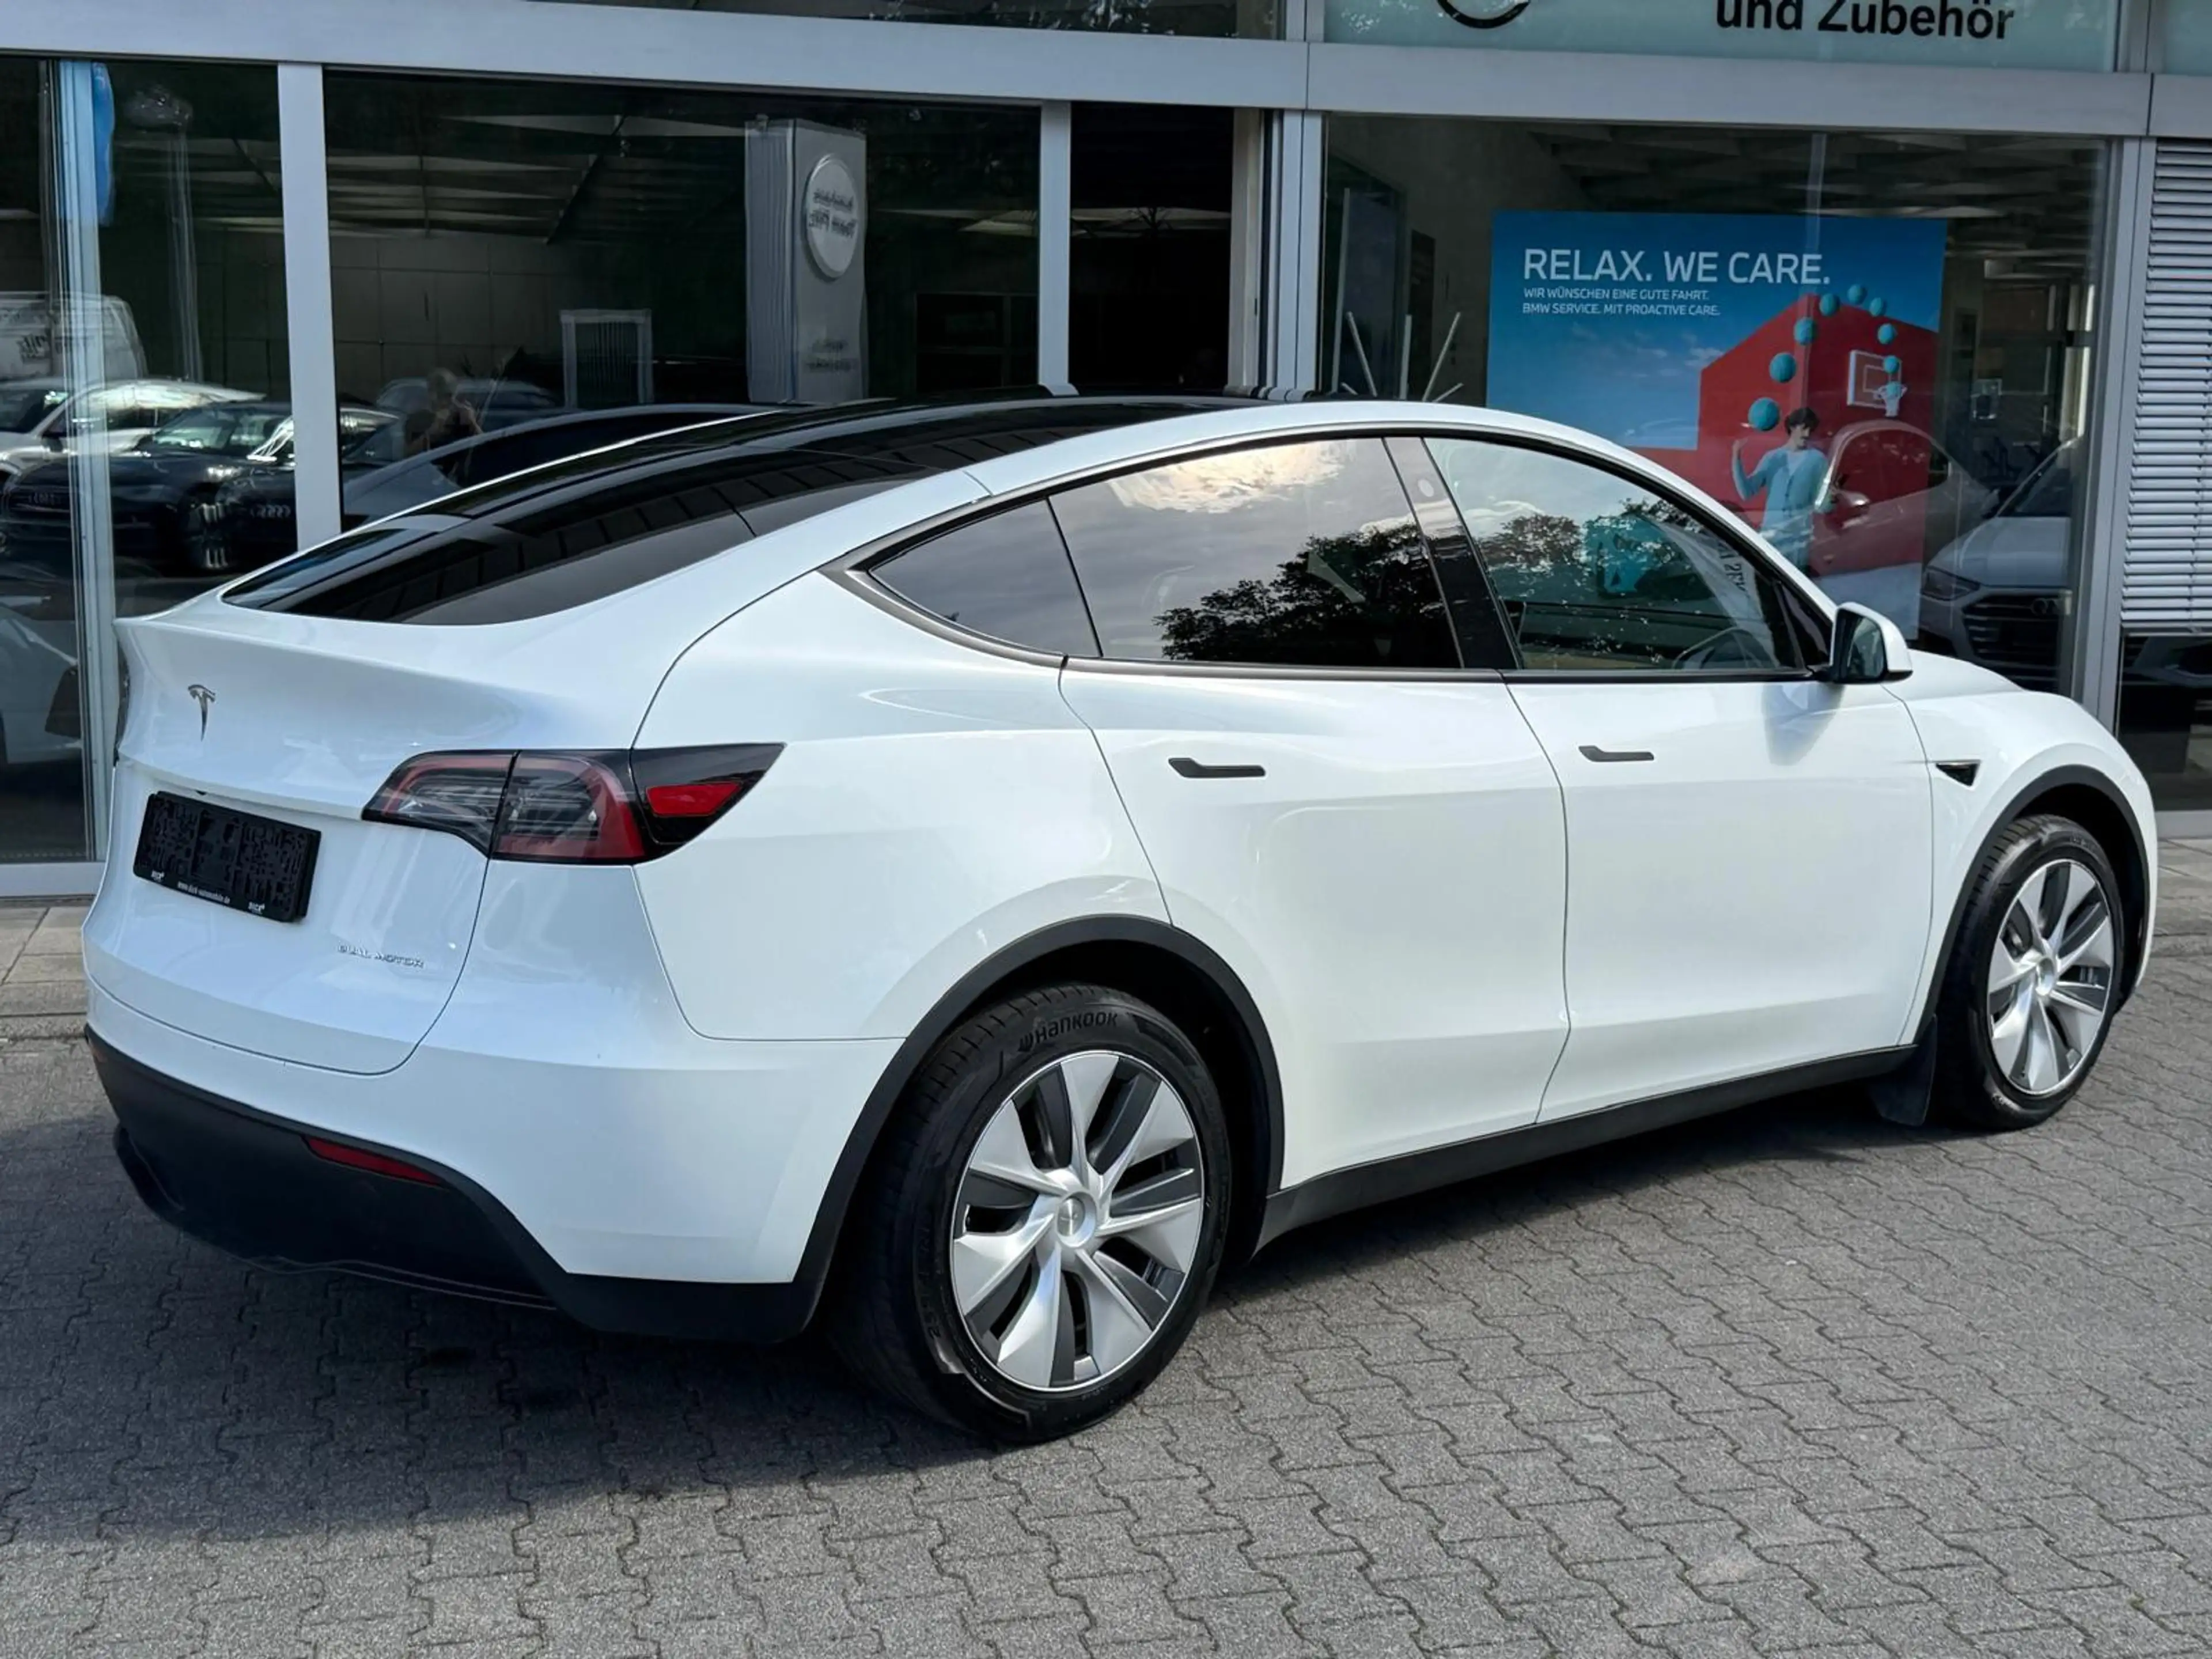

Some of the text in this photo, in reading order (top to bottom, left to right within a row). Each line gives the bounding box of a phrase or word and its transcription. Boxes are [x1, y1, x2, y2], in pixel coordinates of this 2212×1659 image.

[1716, 0, 2014, 40] und Zubehör
[1524, 248, 1831, 285] RELAX. WE CARE.
[1524, 287, 1546, 298] WIR
[1547, 286, 1610, 300] WÜNSCHEN
[1613, 289, 1638, 300] EINE
[1639, 289, 1669, 300] GUTE
[1522, 302, 1551, 314] BMW
[1604, 304, 1624, 315] MIT
[1626, 304, 1687, 315] PROACTIVE
